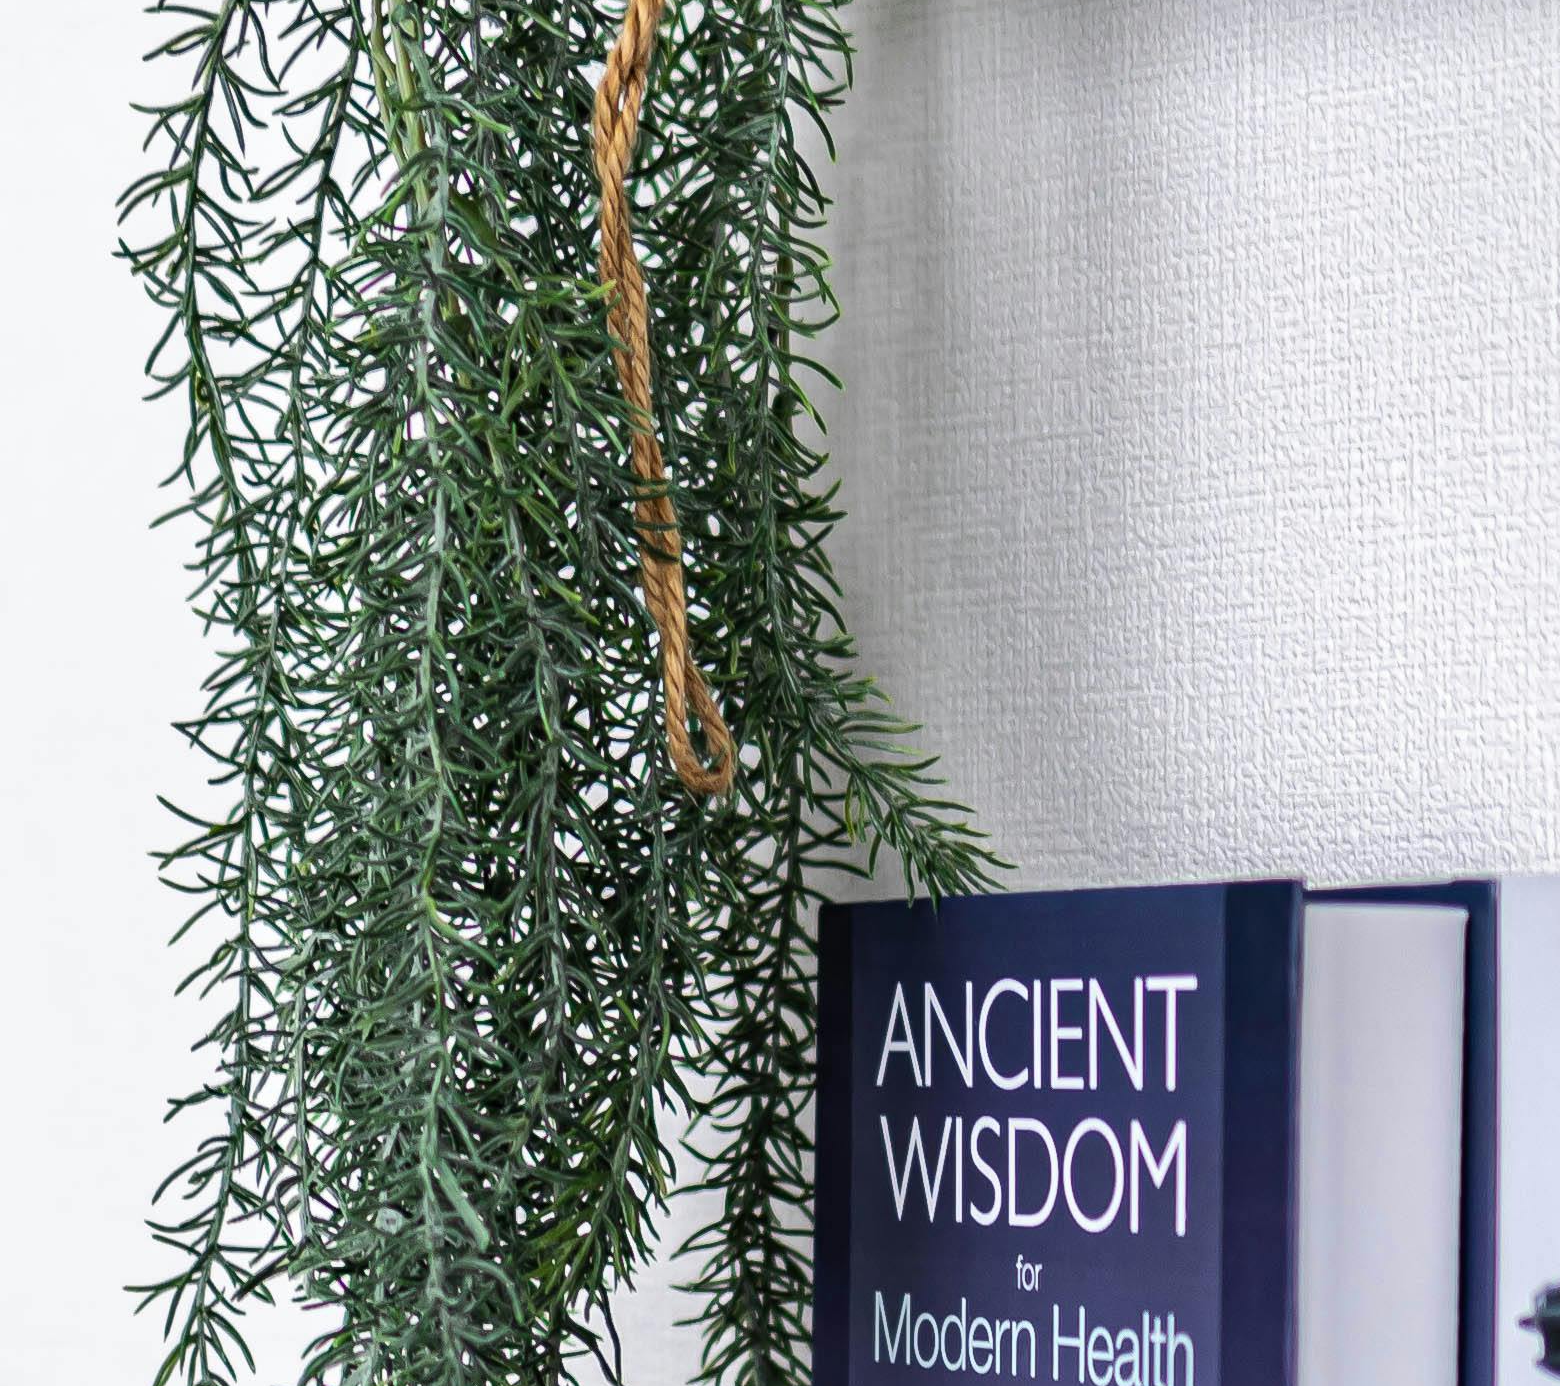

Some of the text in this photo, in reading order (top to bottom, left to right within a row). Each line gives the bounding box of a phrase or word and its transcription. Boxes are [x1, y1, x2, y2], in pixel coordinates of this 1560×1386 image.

[875, 974, 1198, 1093] ANCIENT
[880, 1114, 1188, 1238] WISDOM
[1016, 1253, 1043, 1292] for
[873, 1290, 1037, 1379] Modern
